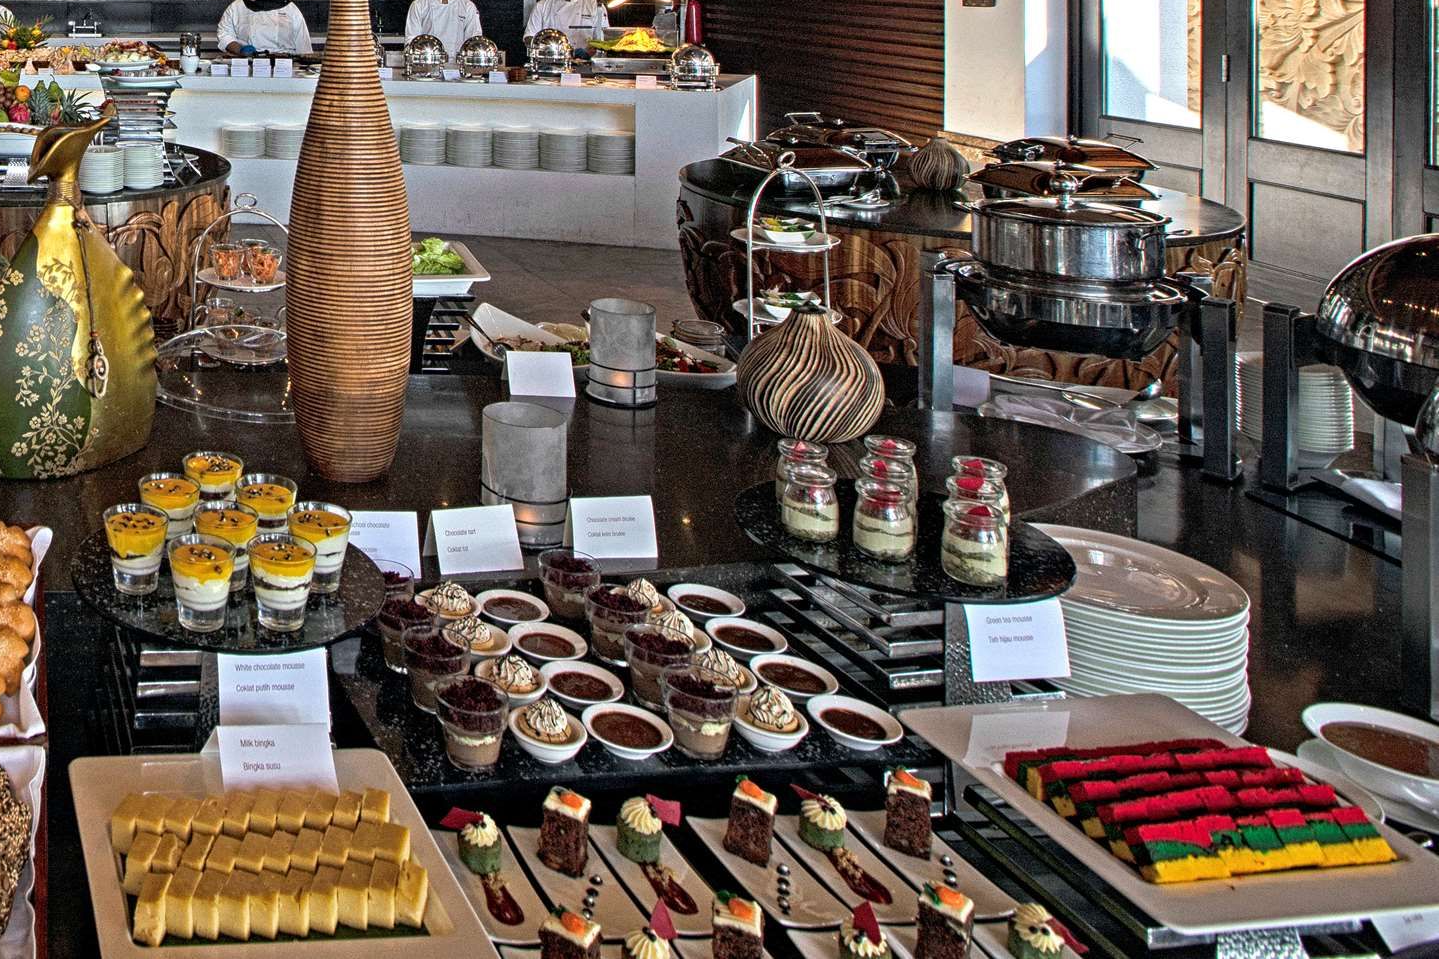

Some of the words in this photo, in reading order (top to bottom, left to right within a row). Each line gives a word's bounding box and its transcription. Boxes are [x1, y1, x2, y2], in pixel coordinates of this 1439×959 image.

[235, 664, 252, 672] White
[253, 663, 280, 671] chocolate
[236, 684, 254, 692] Coklat
[255, 684, 271, 693] putih
[272, 683, 295, 691] mousse
[240, 739, 254, 747] Milk
[255, 739, 275, 748] bingka
[243, 762, 265, 771] Bingka
[266, 762, 281, 770] susu
